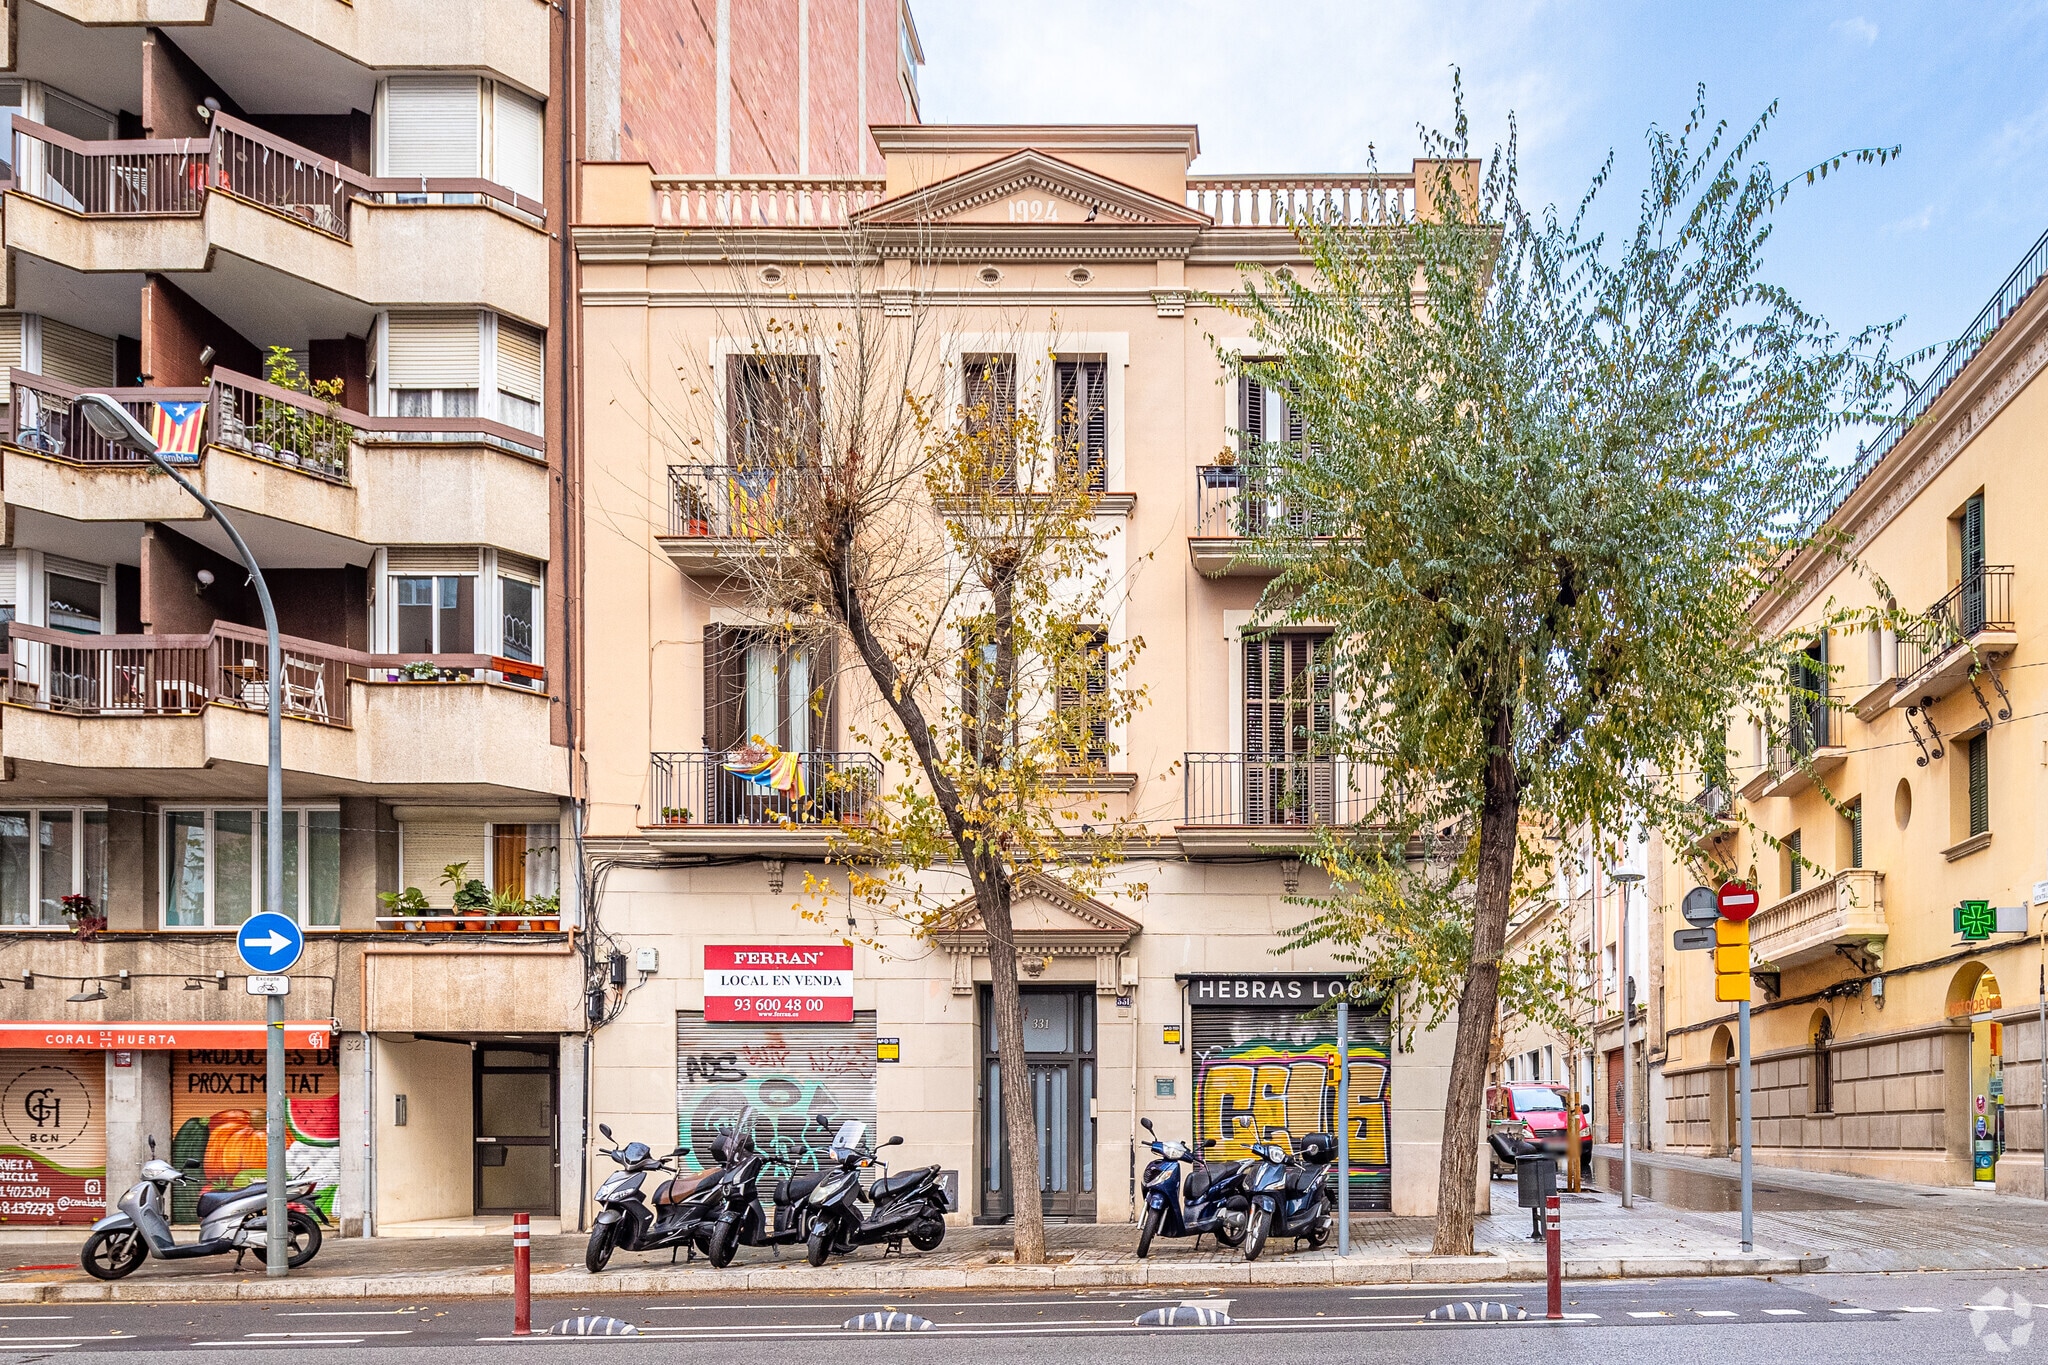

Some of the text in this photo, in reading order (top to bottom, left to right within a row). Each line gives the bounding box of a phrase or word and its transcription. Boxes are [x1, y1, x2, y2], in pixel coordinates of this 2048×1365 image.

[1008, 199, 1059, 223] 1924
[733, 951, 819, 965] FERRAN
[721, 975, 842, 986] LOCAL EN VENDA
[1199, 980, 1377, 999] HEBRAS LOO
[734, 998, 824, 1011] 93 600 48 00
[1032, 1018, 1050, 1029] 331
[45, 1034, 176, 1045] CORAL HUERTA
[188, 1073, 324, 1094] PROXIMTAT
[30, 1133, 59, 1143] BCN
[26, 1160, 34, 1169] A
